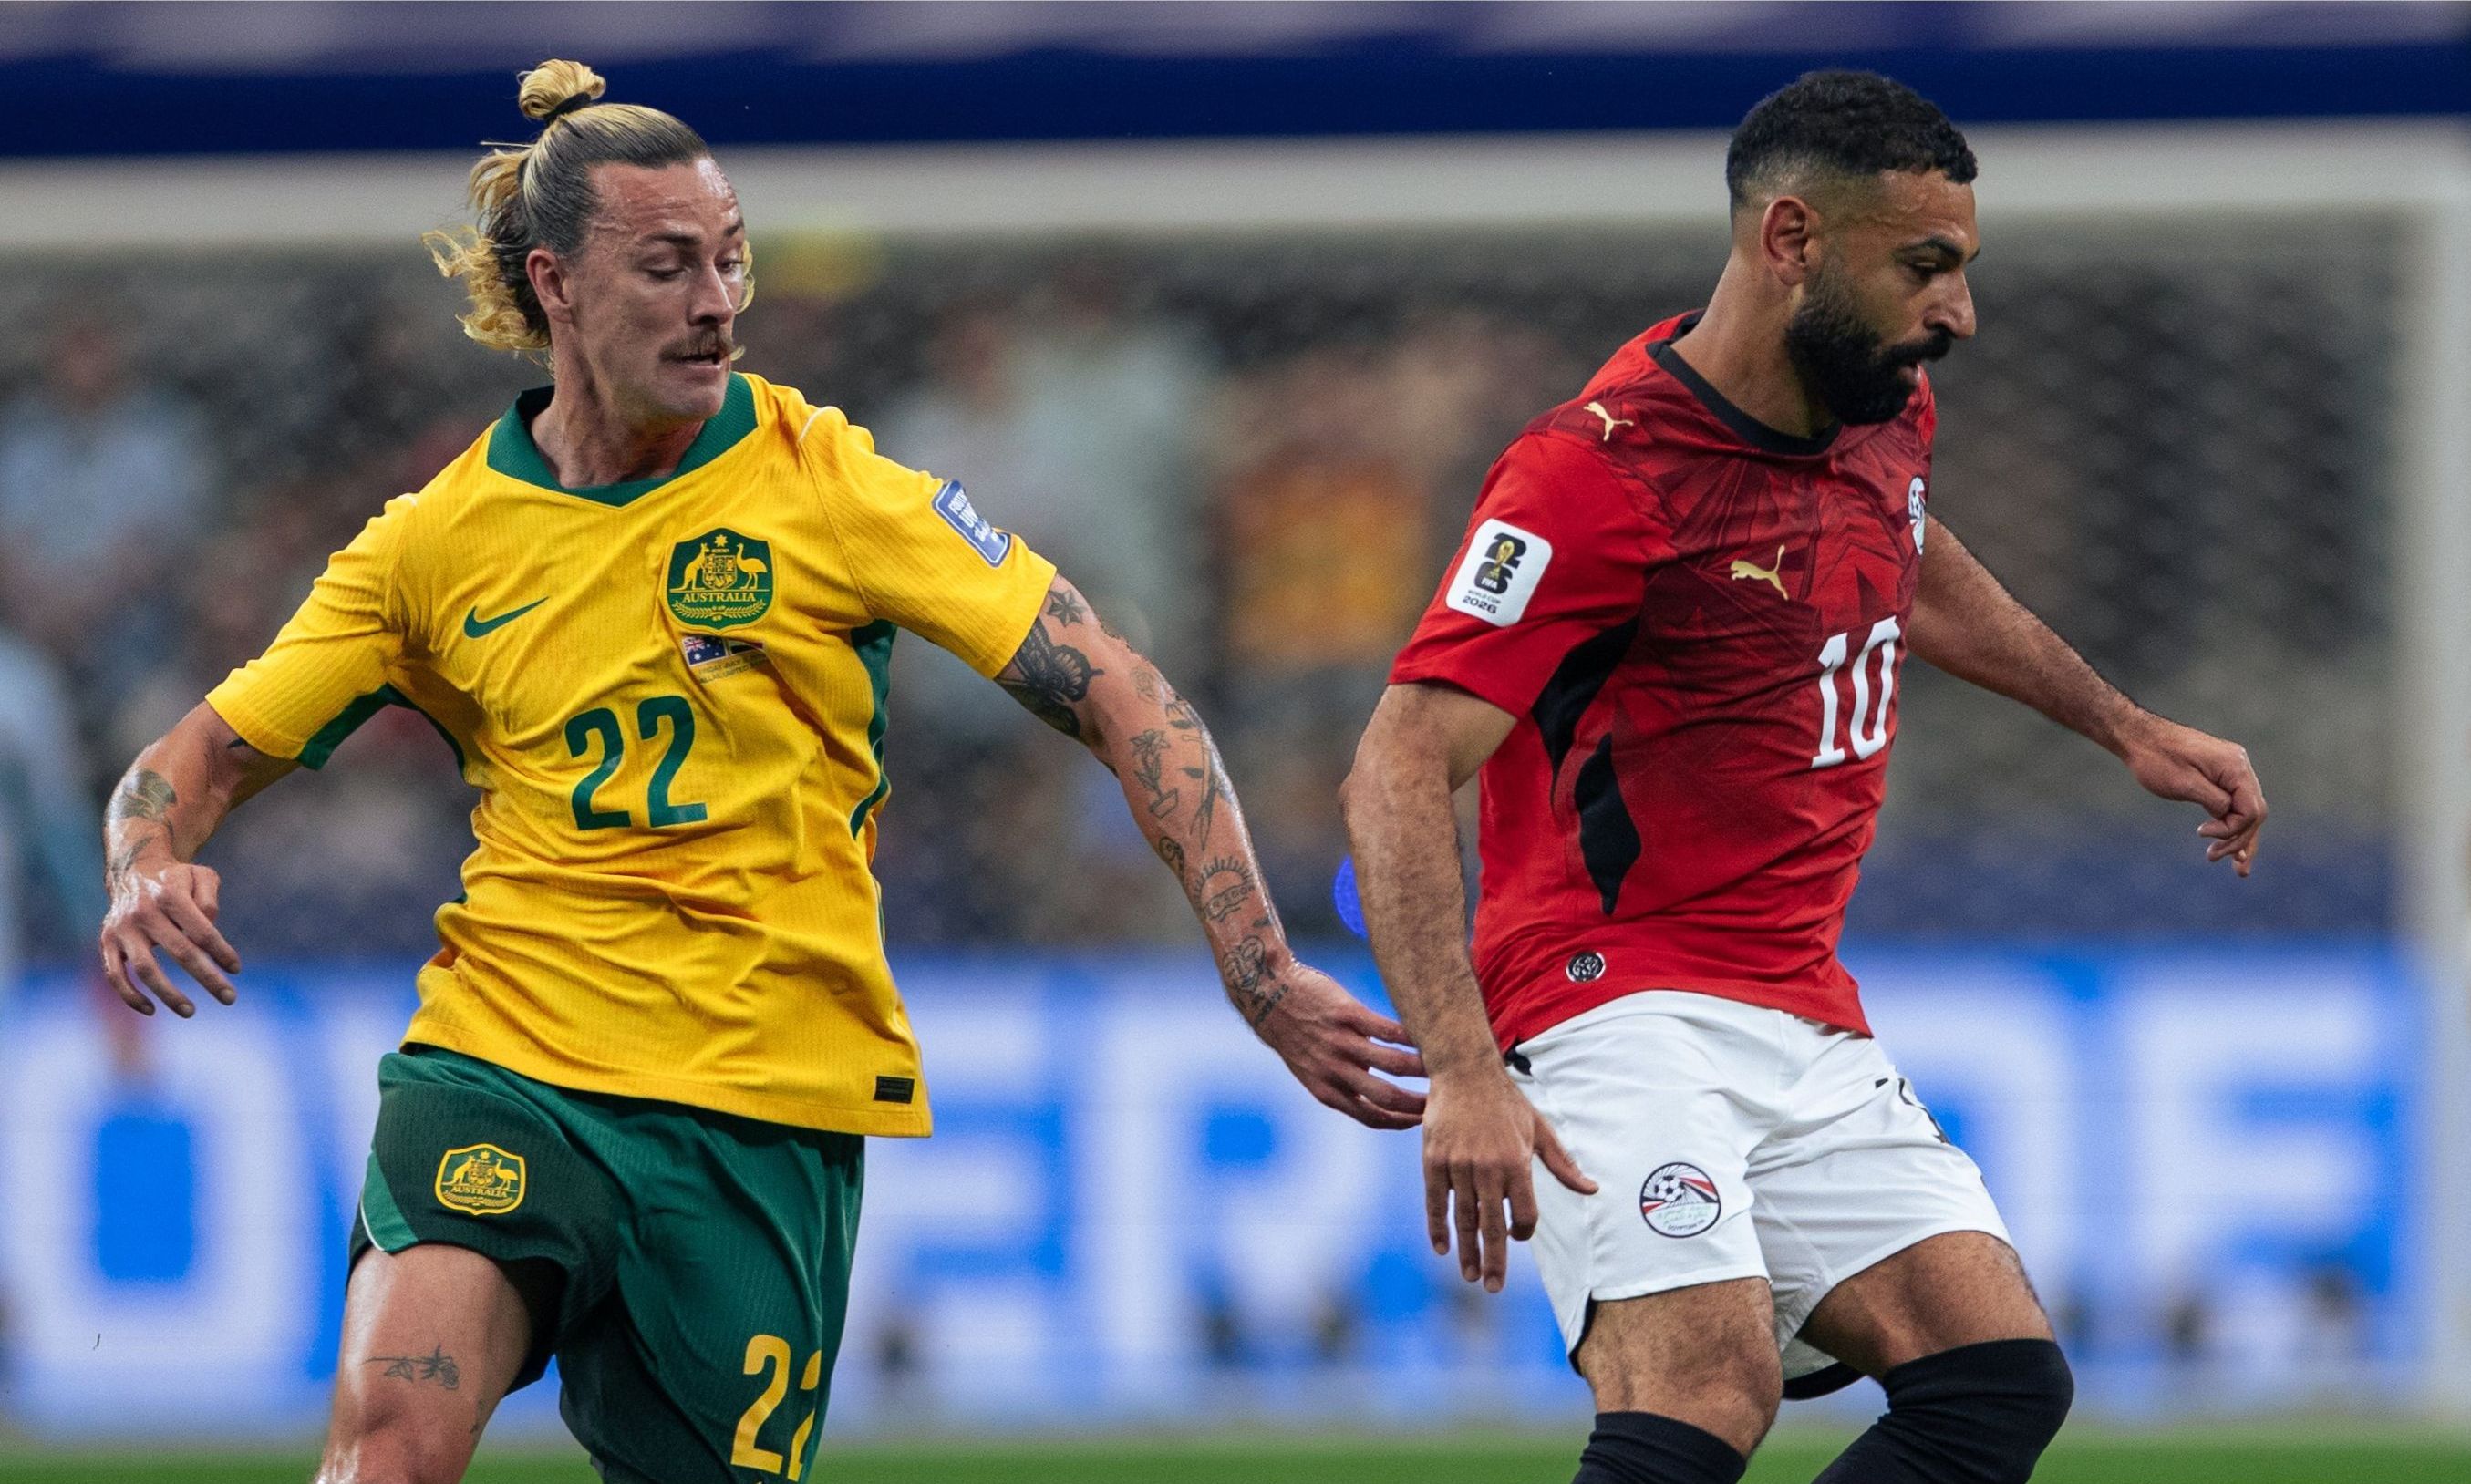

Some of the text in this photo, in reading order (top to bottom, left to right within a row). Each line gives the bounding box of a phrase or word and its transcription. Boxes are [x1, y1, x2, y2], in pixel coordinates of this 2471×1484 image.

[684, 593, 756, 603] AUSTRALIA
[1462, 595, 1497, 614] 2026
[1811, 614, 1901, 768] 10
[564, 695, 708, 830] 22
[452, 1186, 507, 1197] AUSTRALIA
